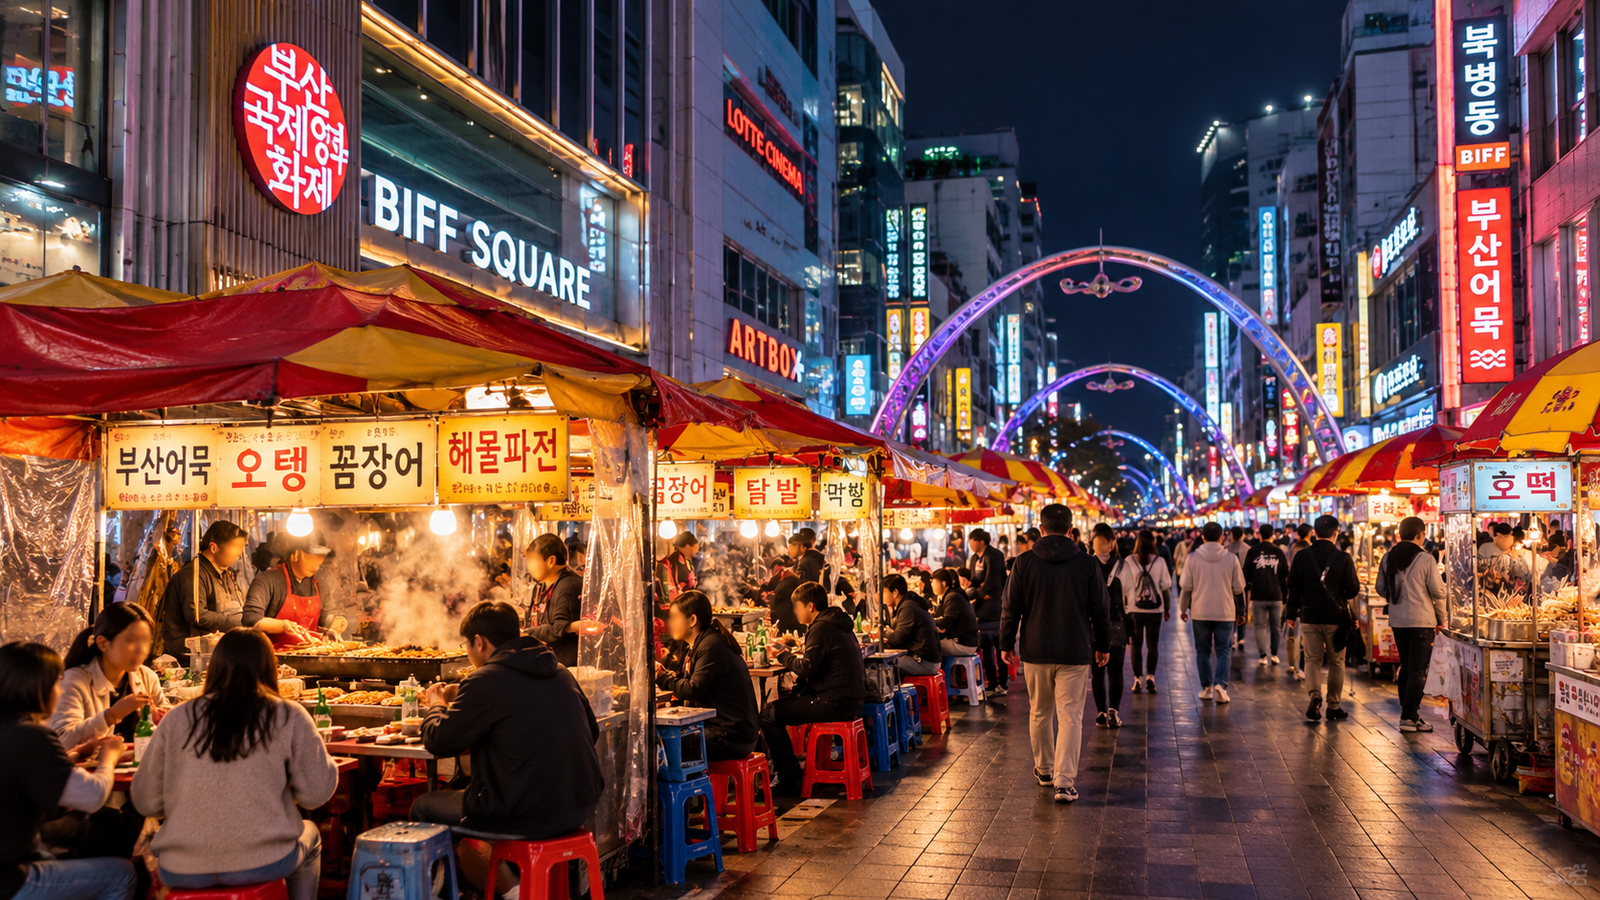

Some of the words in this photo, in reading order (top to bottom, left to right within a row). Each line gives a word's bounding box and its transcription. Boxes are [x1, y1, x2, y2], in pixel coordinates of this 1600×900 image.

[263, 43, 333, 118] 부산
[727, 98, 765, 157] LOTTE
[765, 140, 804, 195] CINEMA
[1460, 146, 1506, 165] BIFF
[374, 173, 459, 254] BIFF
[471, 219, 592, 311] SQUARE
[1466, 198, 1505, 340] 부산어묵
[729, 318, 805, 384] ARTBOX
[116, 445, 212, 487] 부산어묵
[329, 441, 423, 490] 꼼장어
[448, 427, 558, 475] 해물파전
